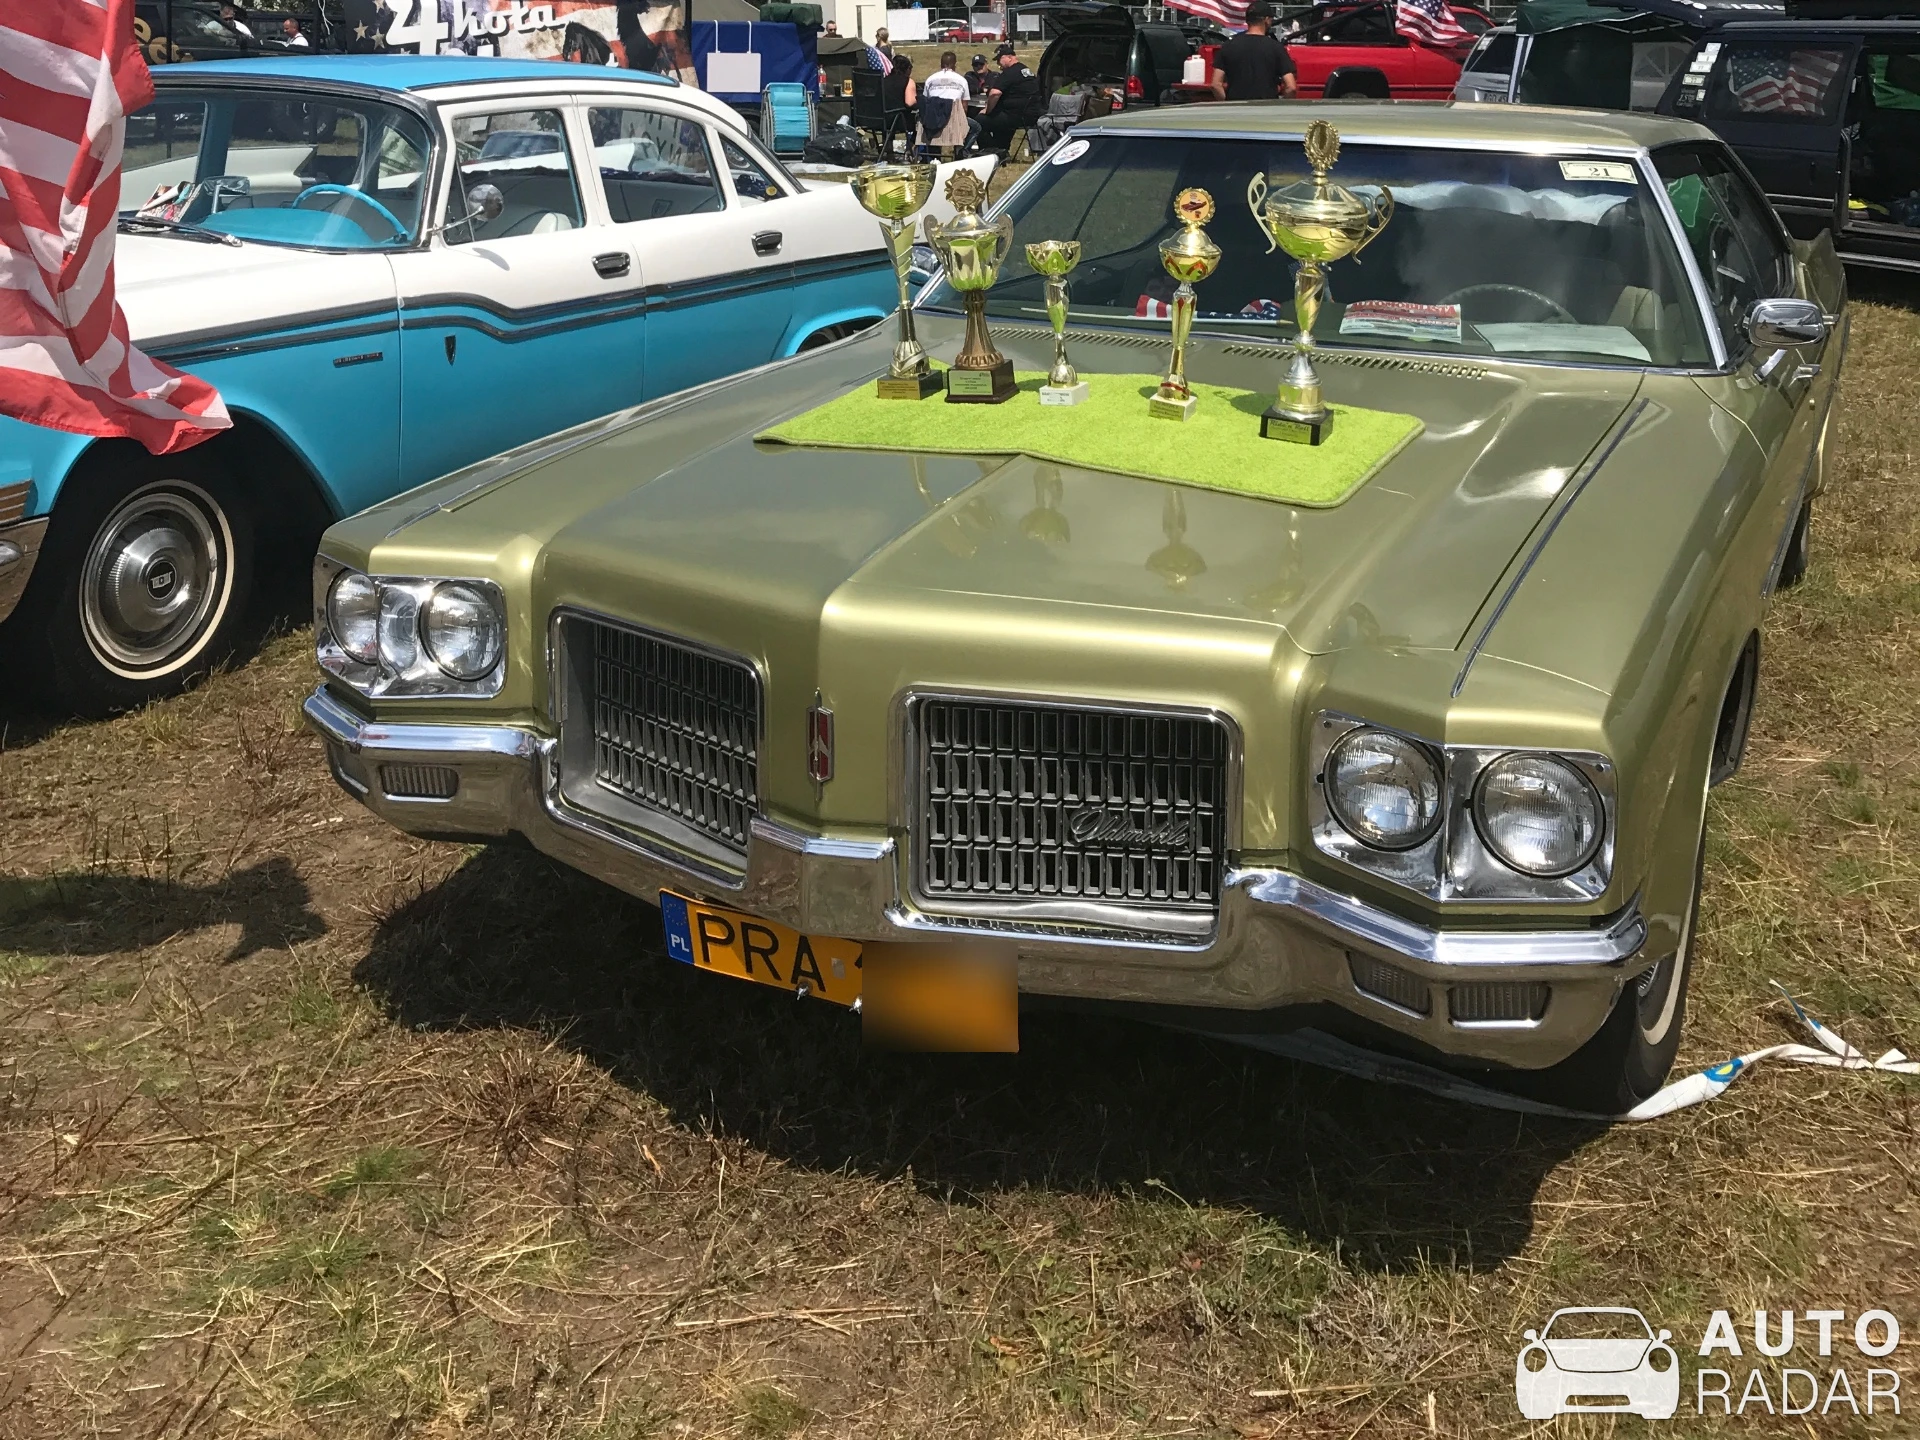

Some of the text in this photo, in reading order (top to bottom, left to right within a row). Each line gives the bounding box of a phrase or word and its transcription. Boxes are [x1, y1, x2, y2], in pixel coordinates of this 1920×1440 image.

[386, 0, 579, 56] 4 koła
[1588, 167, 1610, 177] 21
[670, 934, 690, 953] PL
[696, 911, 827, 993] PRA
